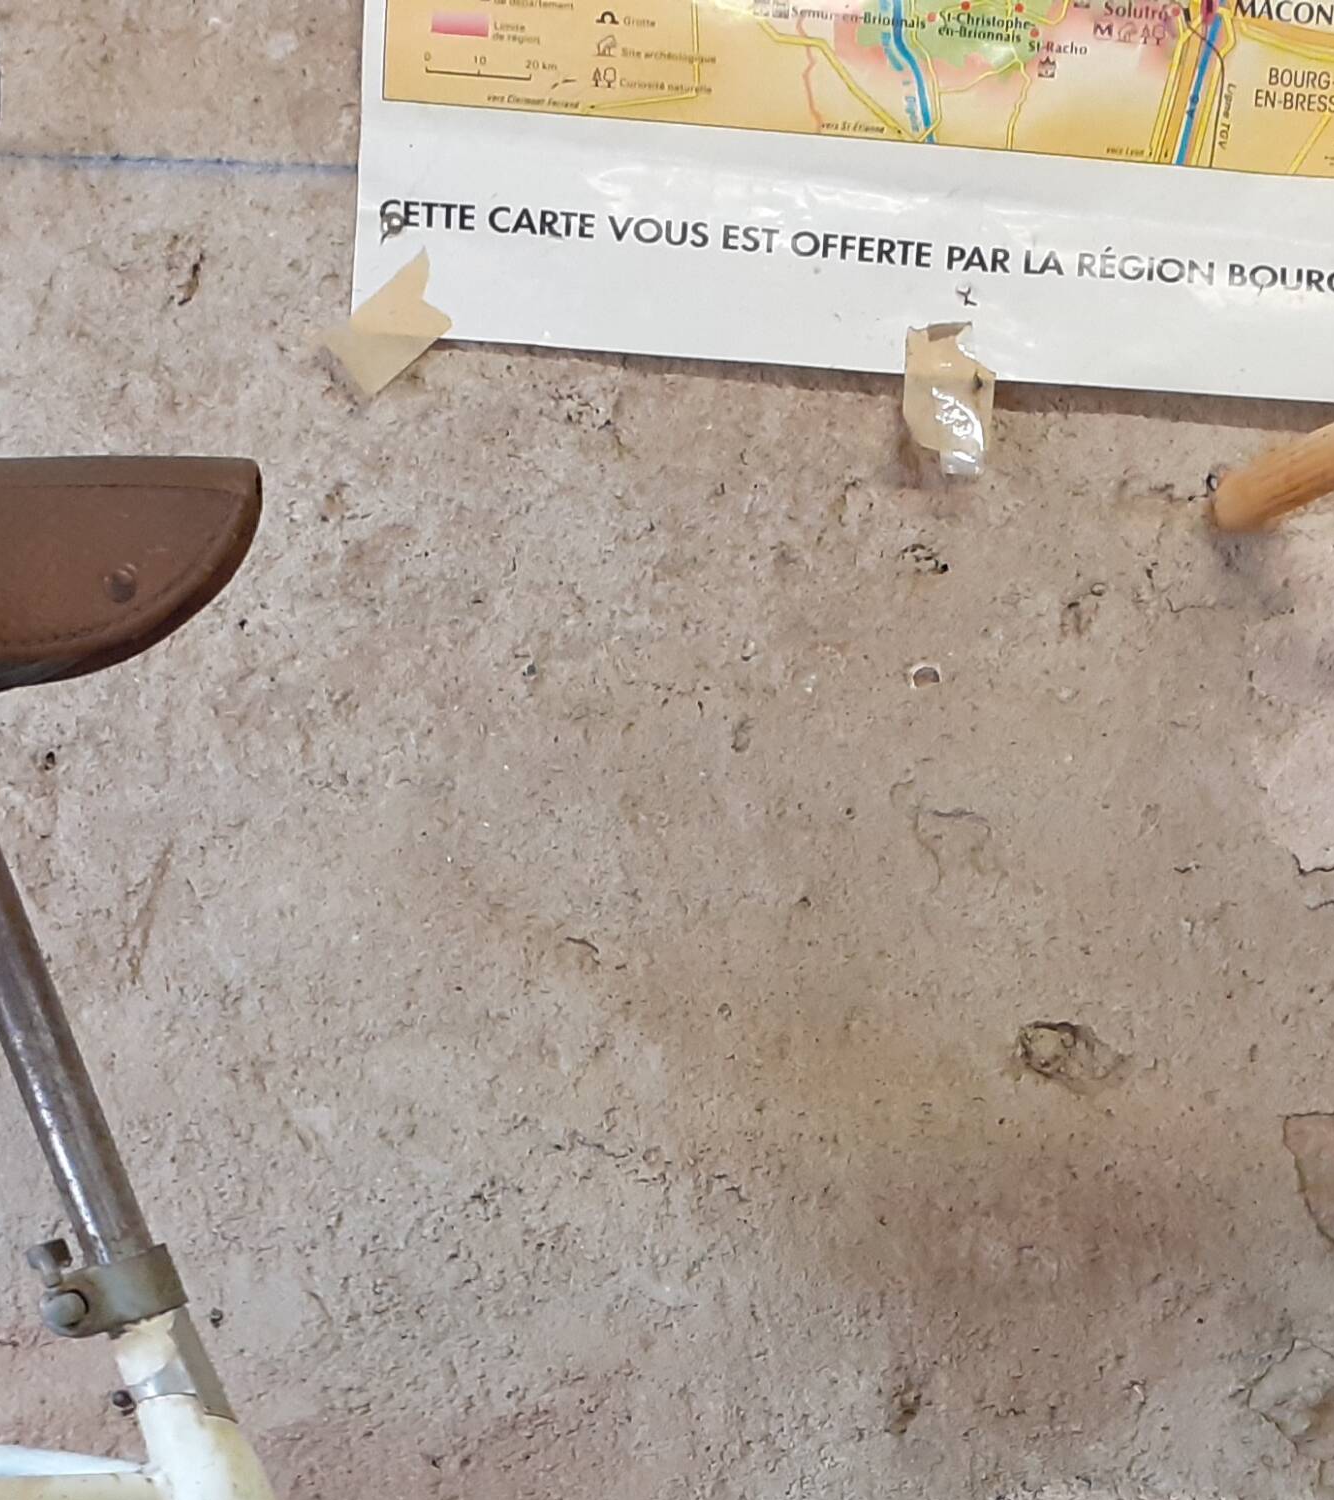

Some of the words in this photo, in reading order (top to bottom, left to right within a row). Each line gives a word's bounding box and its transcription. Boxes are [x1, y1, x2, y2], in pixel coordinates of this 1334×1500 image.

[623, 15, 656, 28] Grotte
[939, 11, 1036, 30] St-Christophe-
[938, 26, 1022, 43] en-Brionnais
[424, 52, 431, 62] 0
[474, 55, 487, 65] 10
[525, 60, 540, 70] 20
[542, 61, 558, 71] km
[619, 78, 665, 91] Curiosité
[1218, 123, 1230, 150] TGV
[488, 206, 595, 240] CARTE
[608, 215, 709, 247] VOUS
[722, 225, 779, 253] EST
[790, 231, 933, 268] OFFERTE
[946, 245, 1010, 273] PAR
[1023, 249, 1064, 276] LA
[1077, 246, 1215, 285] RÉGION
